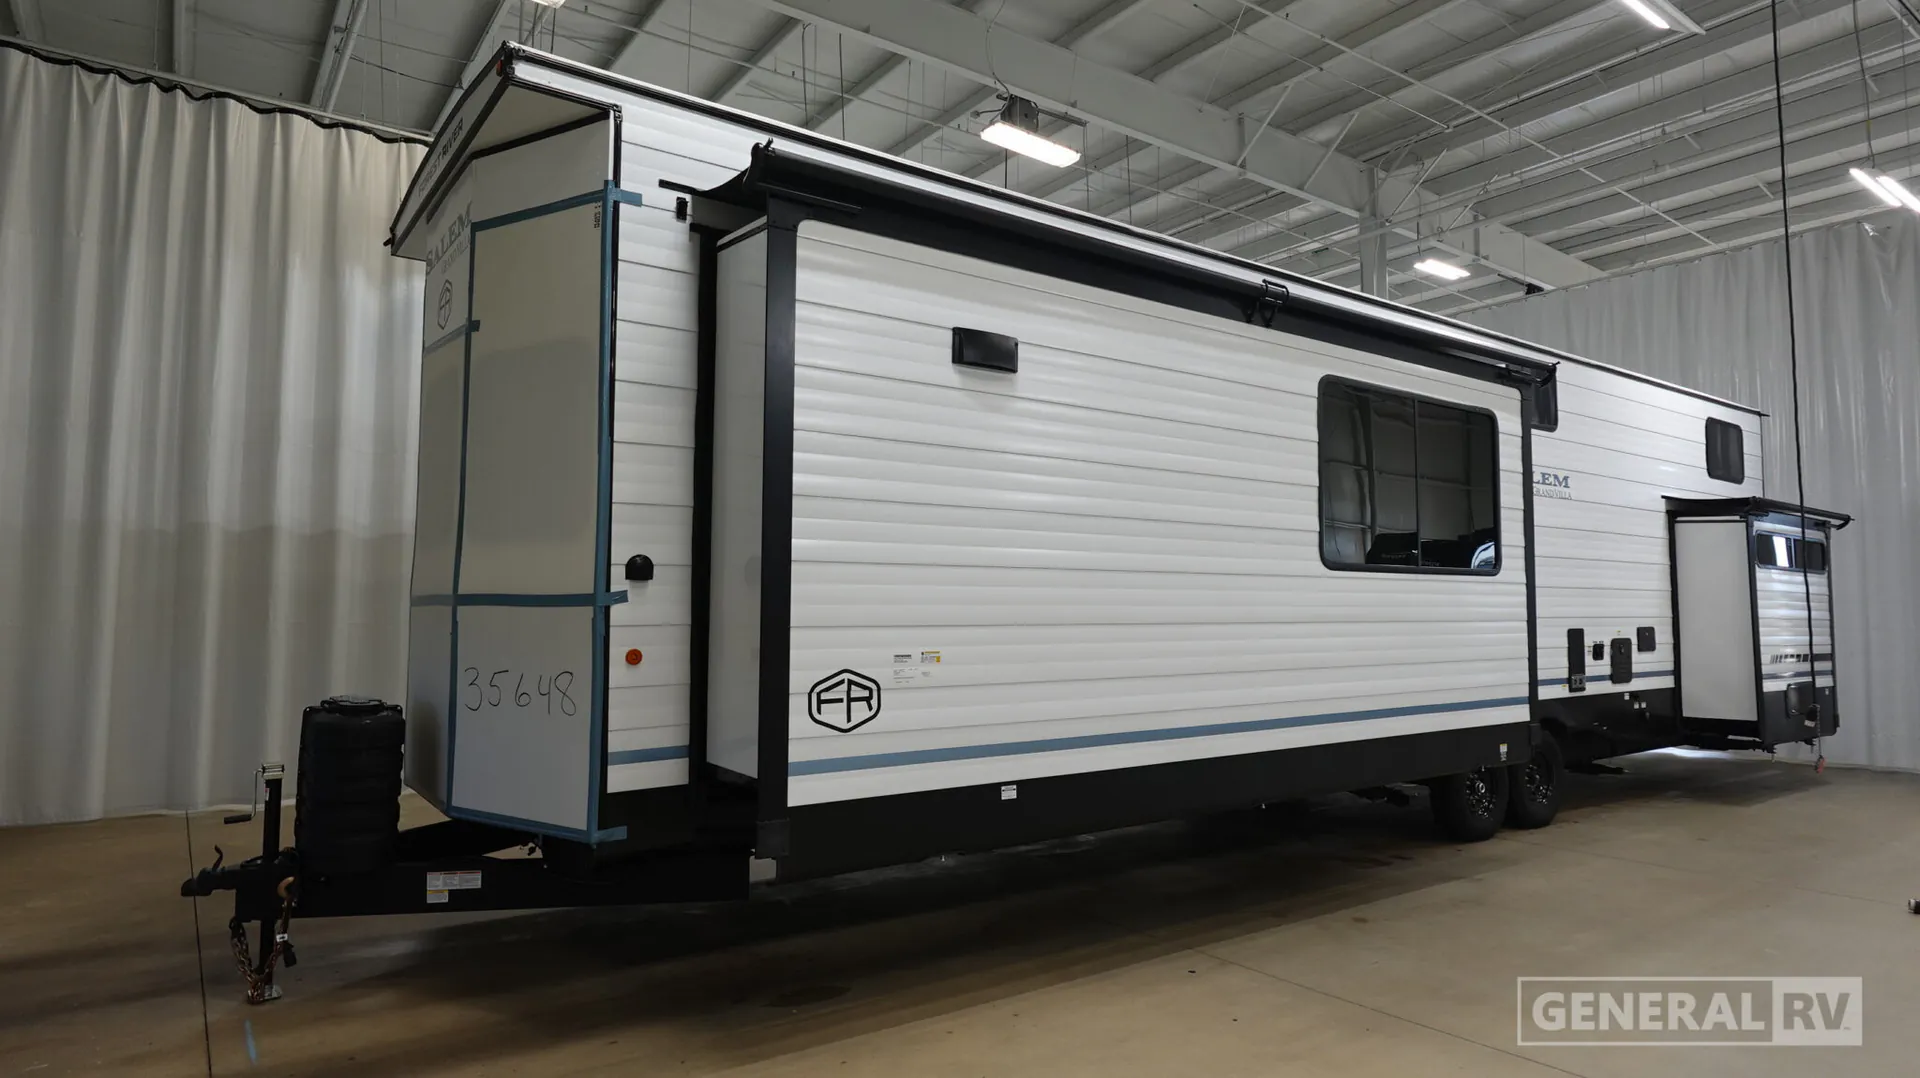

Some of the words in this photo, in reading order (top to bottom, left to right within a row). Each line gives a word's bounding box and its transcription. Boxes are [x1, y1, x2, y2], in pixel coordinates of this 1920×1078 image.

[418, 151, 442, 197] FOREST
[441, 117, 464, 159] RIVER
[426, 200, 472, 275] SALEM
[464, 666, 577, 717] 35648
